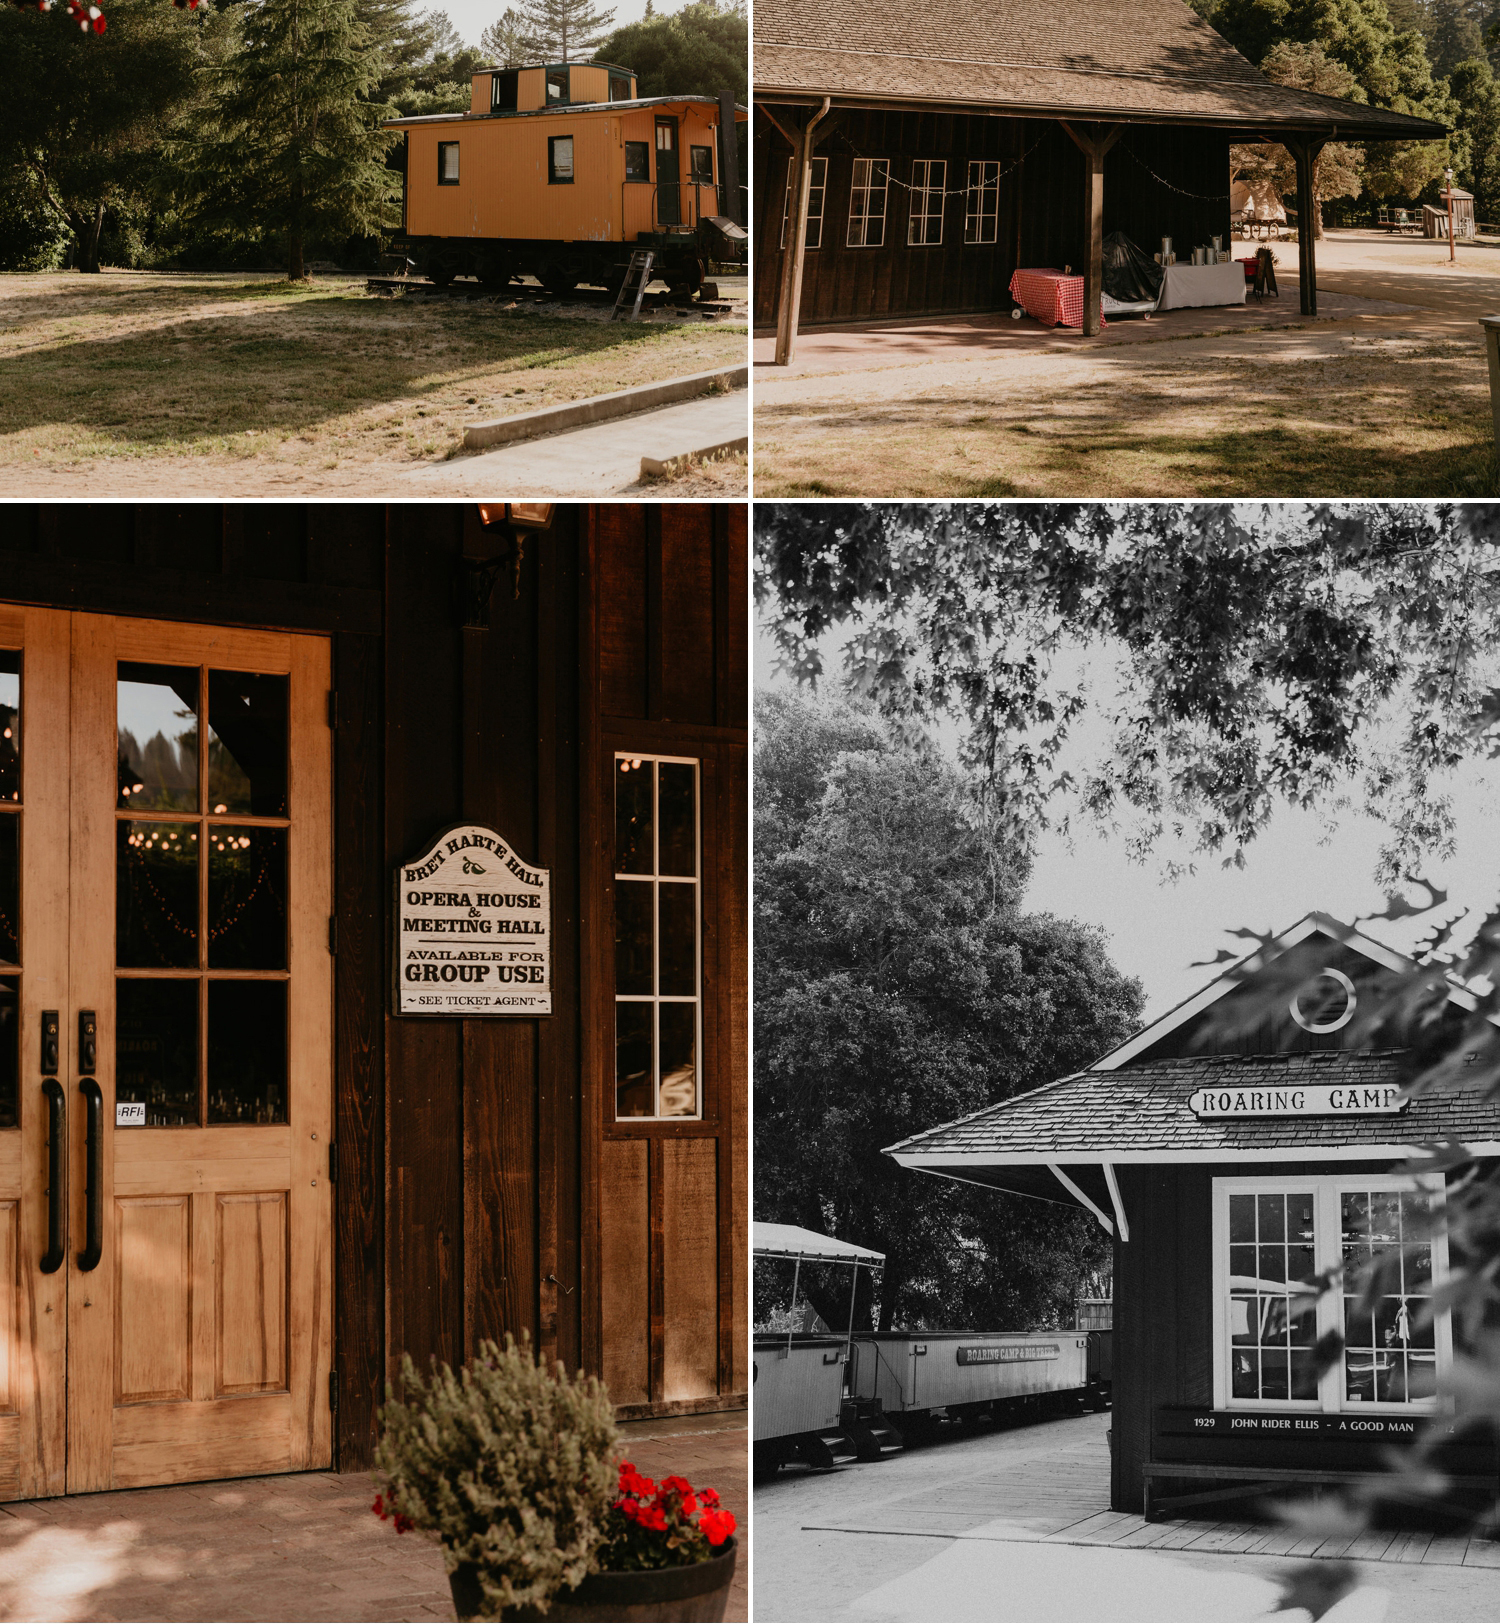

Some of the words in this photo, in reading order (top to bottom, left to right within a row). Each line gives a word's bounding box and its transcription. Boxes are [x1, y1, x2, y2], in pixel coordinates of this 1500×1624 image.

[404, 850, 447, 883] BRET
[445, 834, 508, 860] HARTE
[504, 857, 544, 887] HALL
[406, 891, 472, 907] OPERA
[476, 893, 541, 908] HOUSE
[468, 906, 481, 918] &
[403, 918, 492, 934] MEETING
[497, 920, 545, 935] HALL
[406, 950, 503, 962] AVAILABLE
[508, 952, 545, 962] FOR
[405, 963, 490, 982] GROUP
[497, 965, 545, 983] USE
[418, 996, 443, 1005] SEE
[445, 996, 491, 1005] TICKET
[493, 996, 537, 1006] AGENT
[1202, 1091, 1305, 1111] ROARING
[1329, 1088, 1398, 1109] CAMP
[121, 1107, 141, 1117] RFI
[966, 1348, 999, 1361] ROARING
[1000, 1348, 1019, 1359] CAMP
[1025, 1347, 1036, 1358] BIG
[1036, 1347, 1055, 1357] TREES
[1194, 1418, 1216, 1427] 1929
[1231, 1418, 1258, 1429] JOHN
[1261, 1419, 1291, 1429] RIDER
[1295, 1420, 1319, 1429] ELLIS
[1339, 1421, 1347, 1430] A
[1350, 1421, 1384, 1431] GOOD
[1388, 1422, 1414, 1432] MAN
[1431, 1423, 1454, 1434] 212
